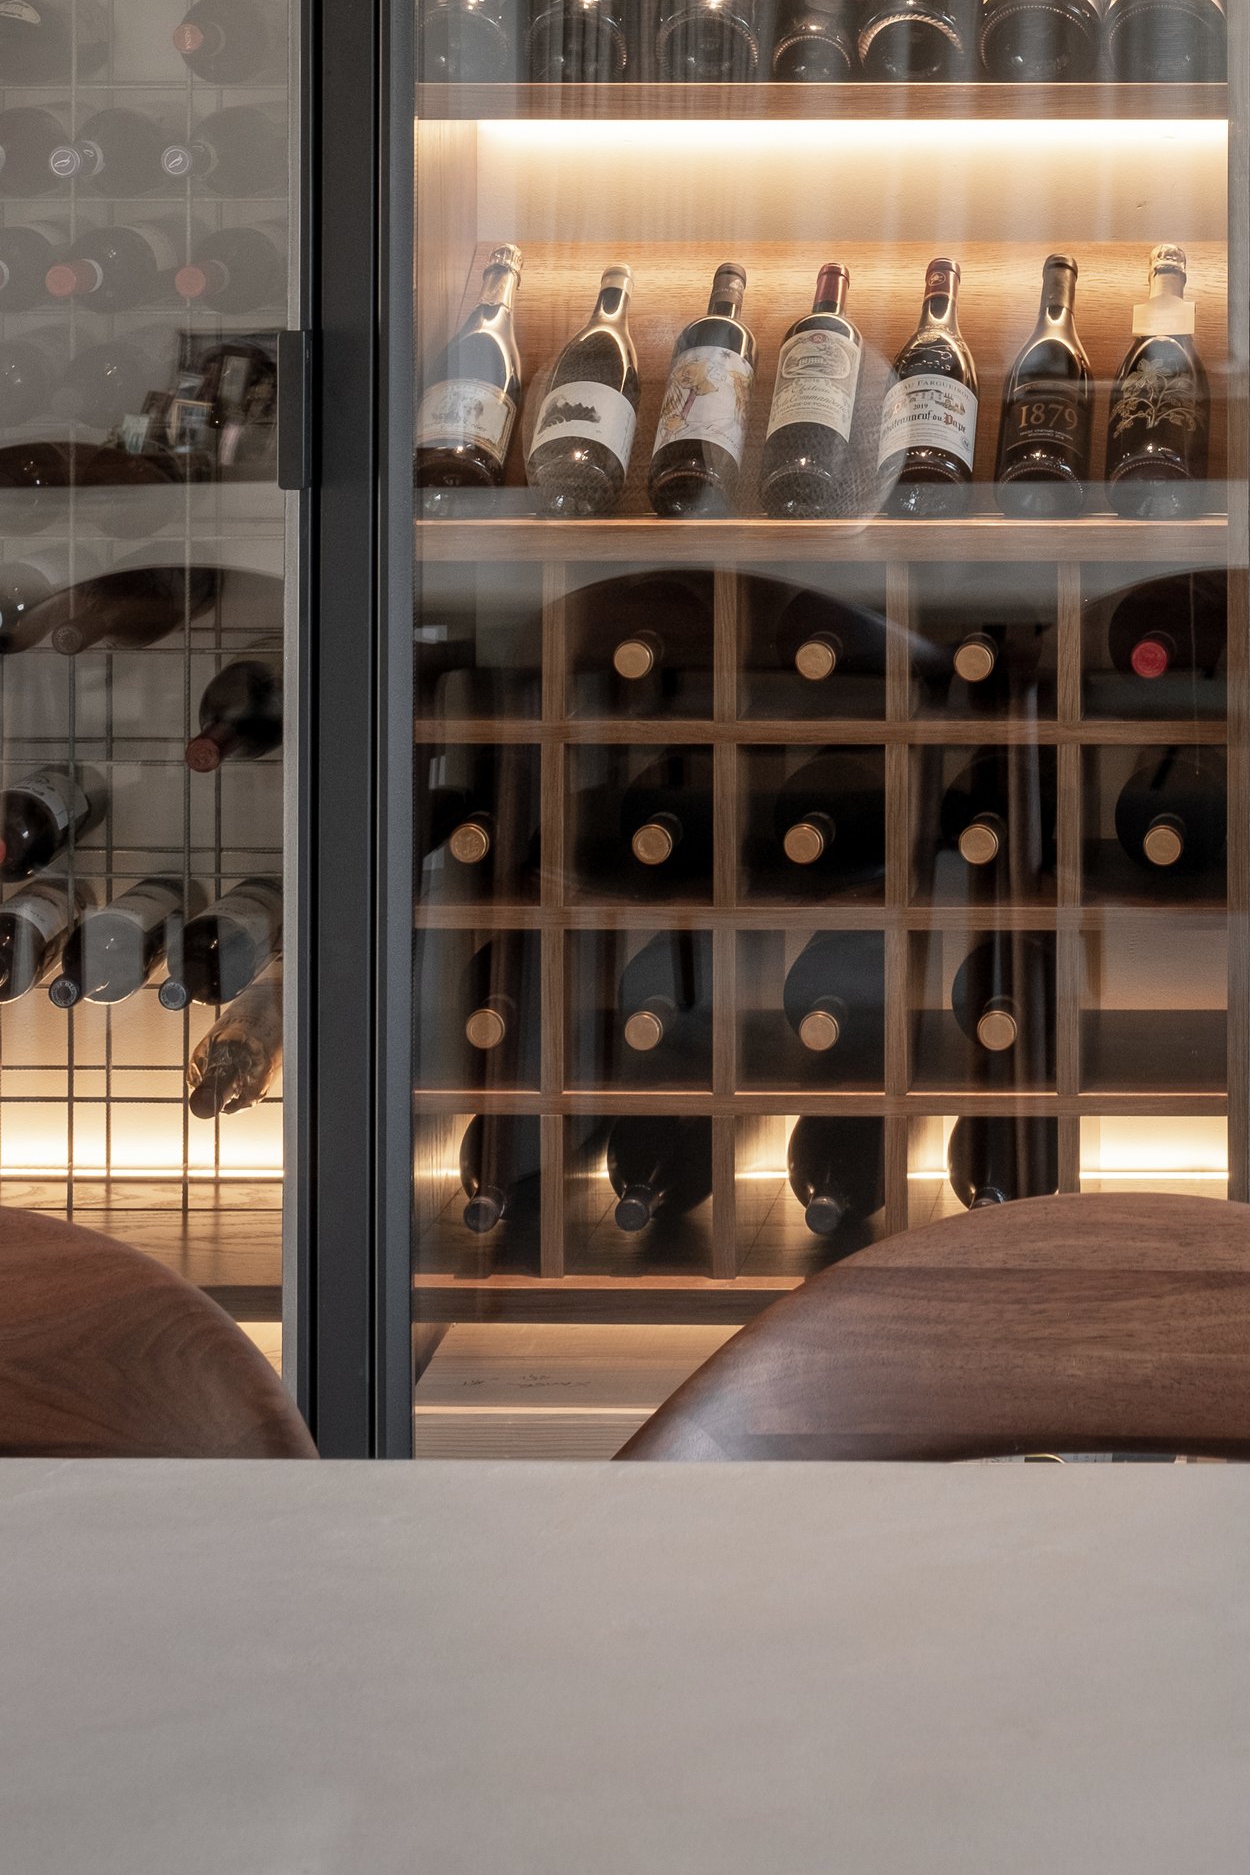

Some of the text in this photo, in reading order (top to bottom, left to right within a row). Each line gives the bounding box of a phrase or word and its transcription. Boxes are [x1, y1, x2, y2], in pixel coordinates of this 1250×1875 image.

[912, 403, 929, 411] 2019
[1018, 402, 1079, 430] 1879
[943, 411, 967, 434] Pape
